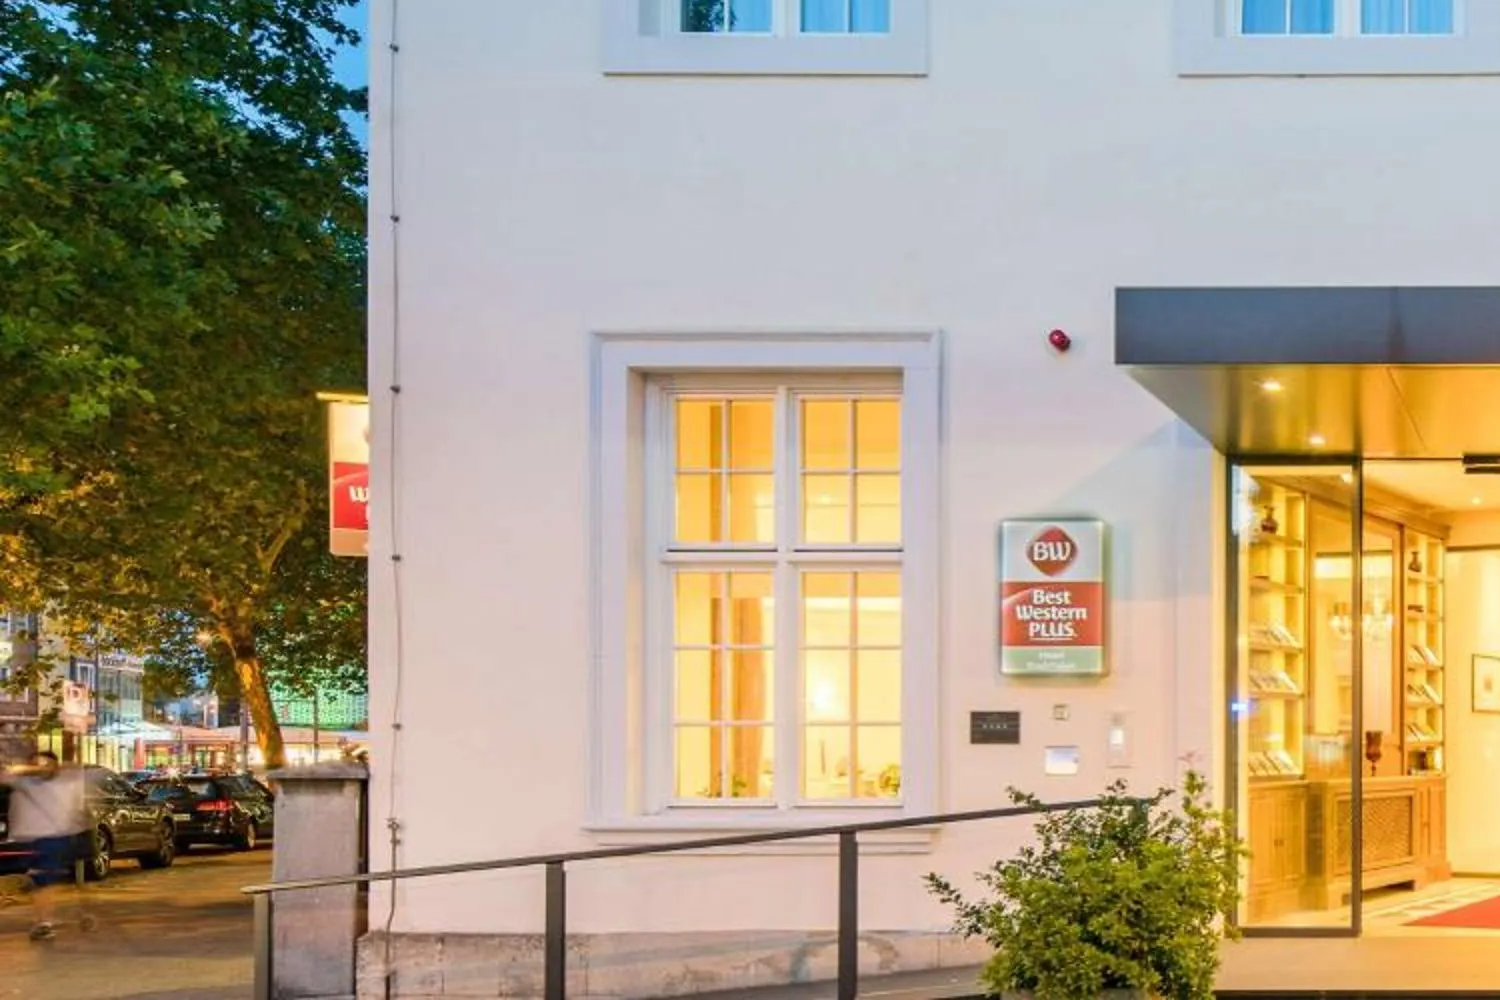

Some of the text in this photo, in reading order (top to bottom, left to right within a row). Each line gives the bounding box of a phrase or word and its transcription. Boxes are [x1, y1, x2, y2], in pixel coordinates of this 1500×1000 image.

[1032, 541, 1072, 561] BW
[1032, 588, 1072, 605] Best
[1015, 604, 1088, 621] Western
[1028, 621, 1075, 638] PLUS
